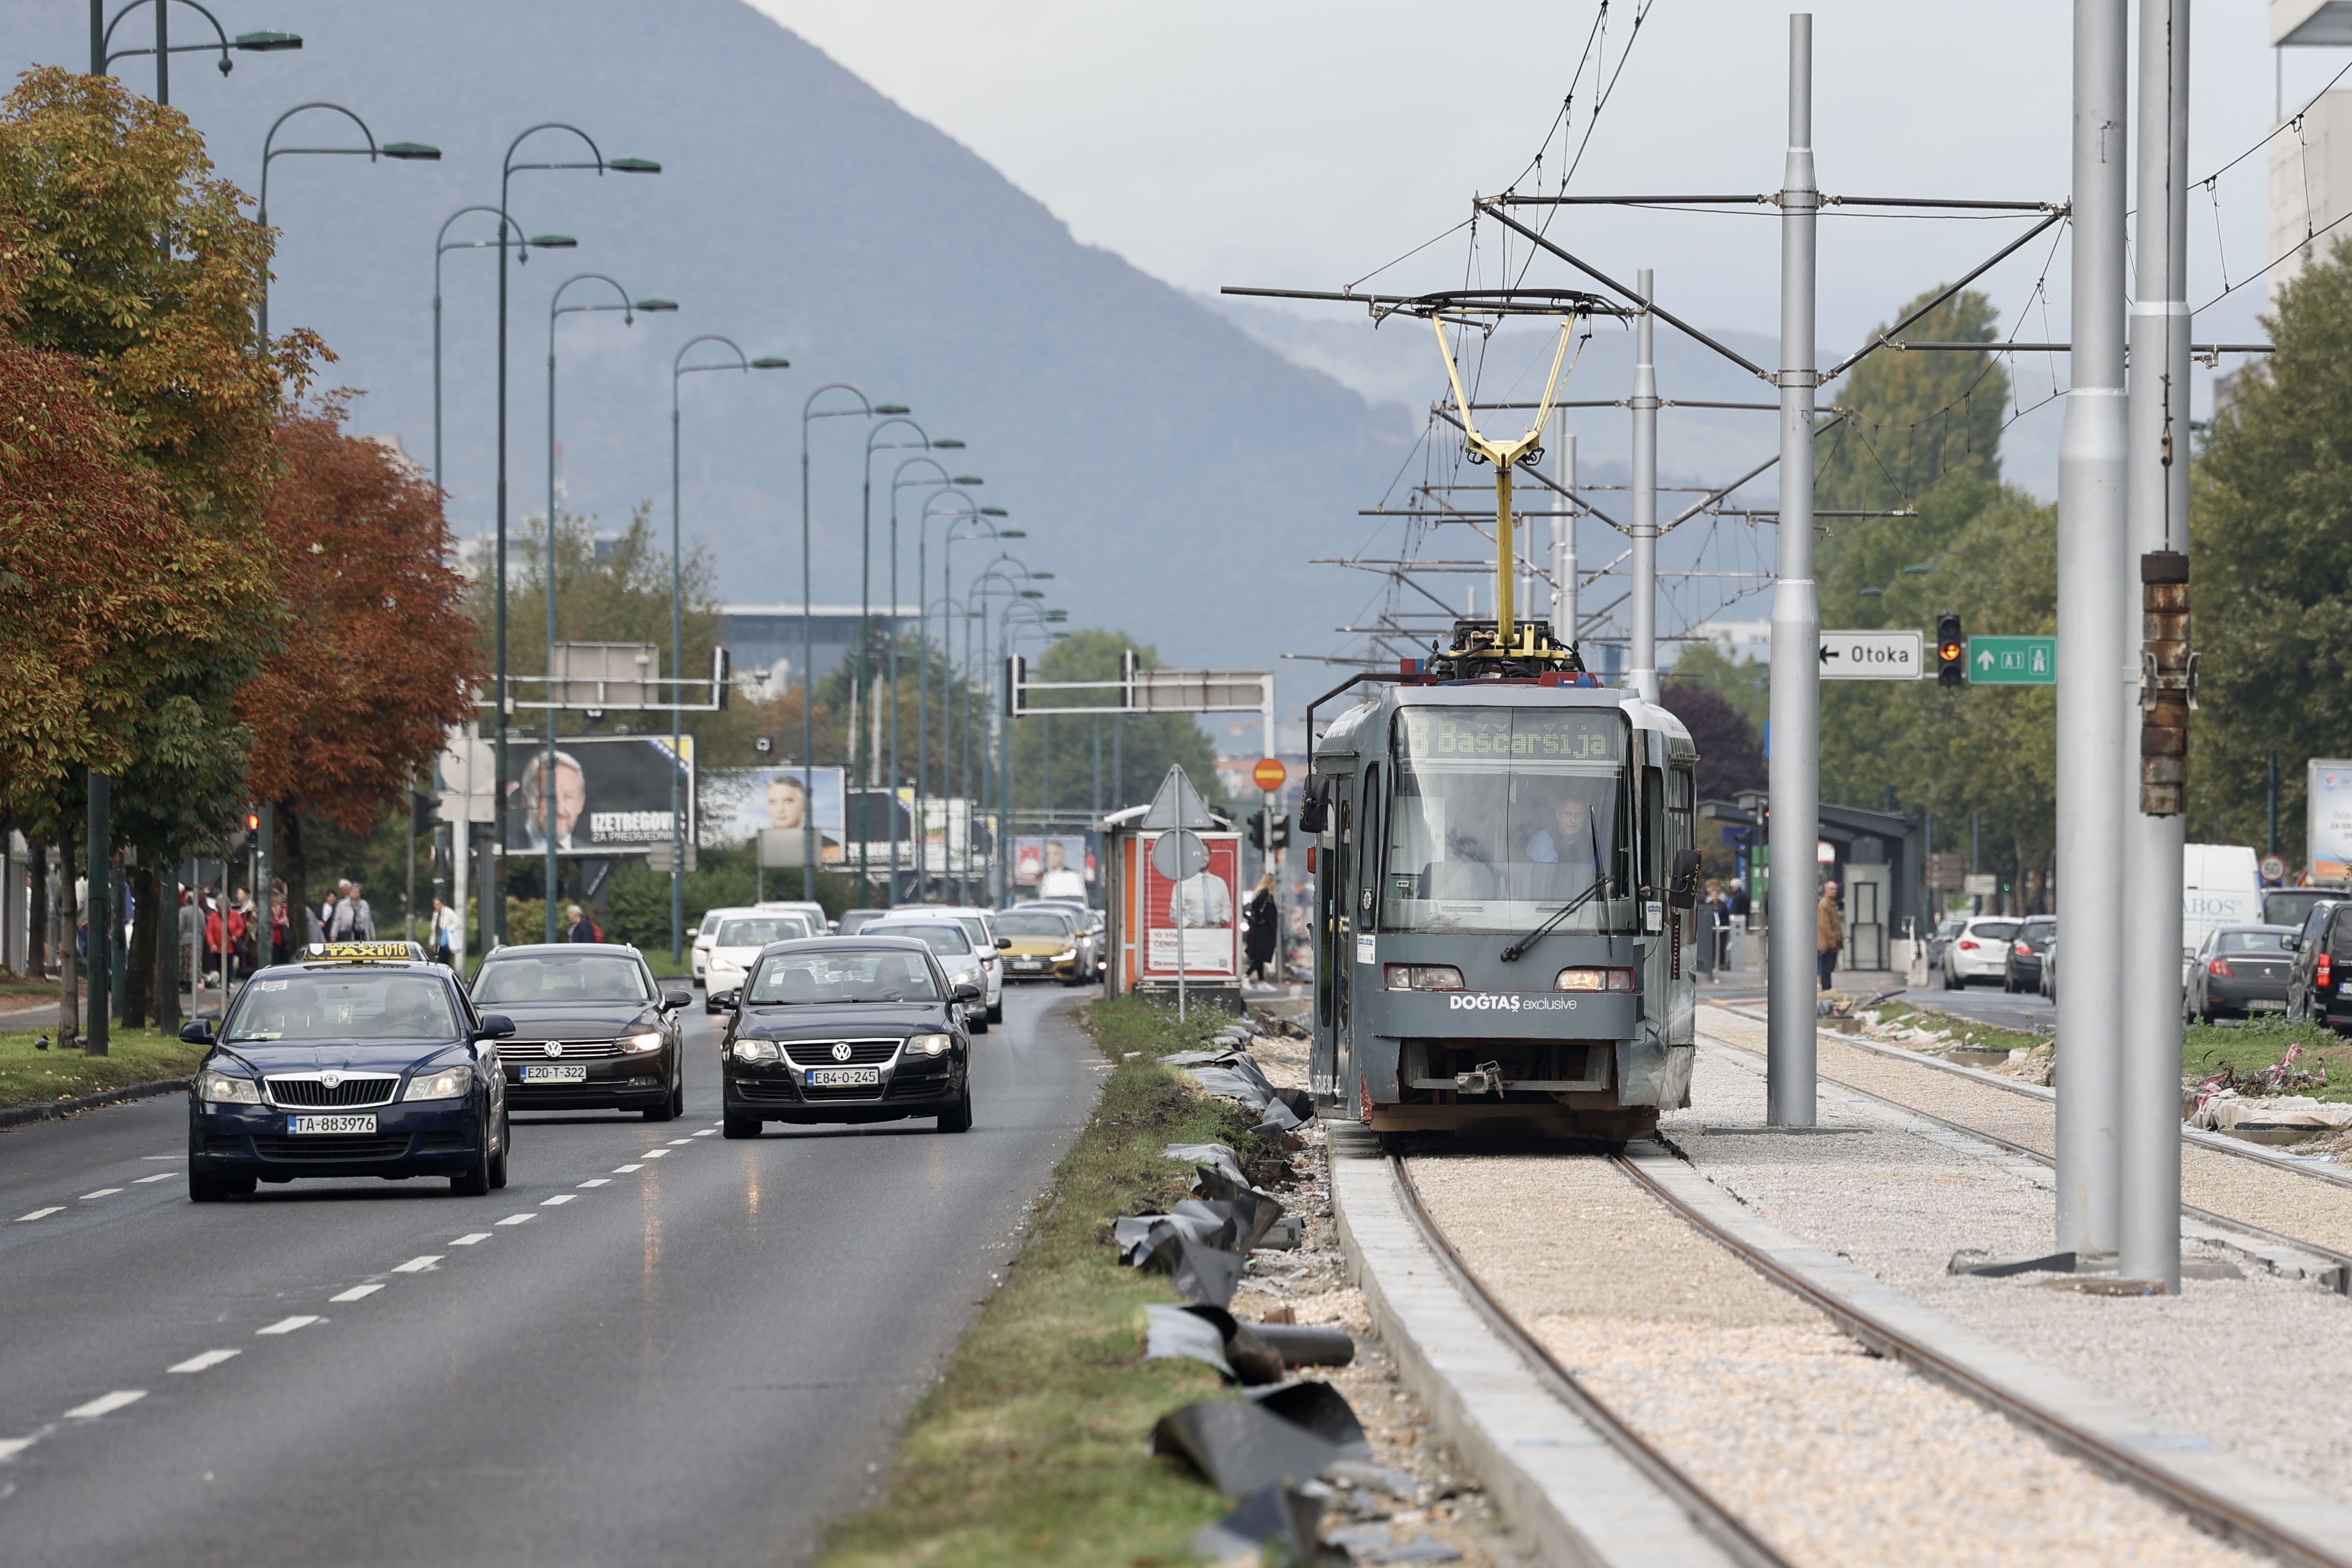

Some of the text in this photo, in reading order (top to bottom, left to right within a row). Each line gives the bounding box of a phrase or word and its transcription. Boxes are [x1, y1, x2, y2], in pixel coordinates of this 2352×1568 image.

[1851, 645, 1908, 662] Otoka
[2005, 654, 2021, 667] A1
[1409, 719, 1606, 758] 3 Baščaršija
[1691, 864, 1700, 895] 545
[325, 948, 384, 956] TAXI
[385, 944, 406, 956] 016
[1450, 993, 1577, 1013] DOĞTAŞ exclusive
[528, 1067, 584, 1078] E20-T-322
[297, 1117, 374, 1131] TA-883976
